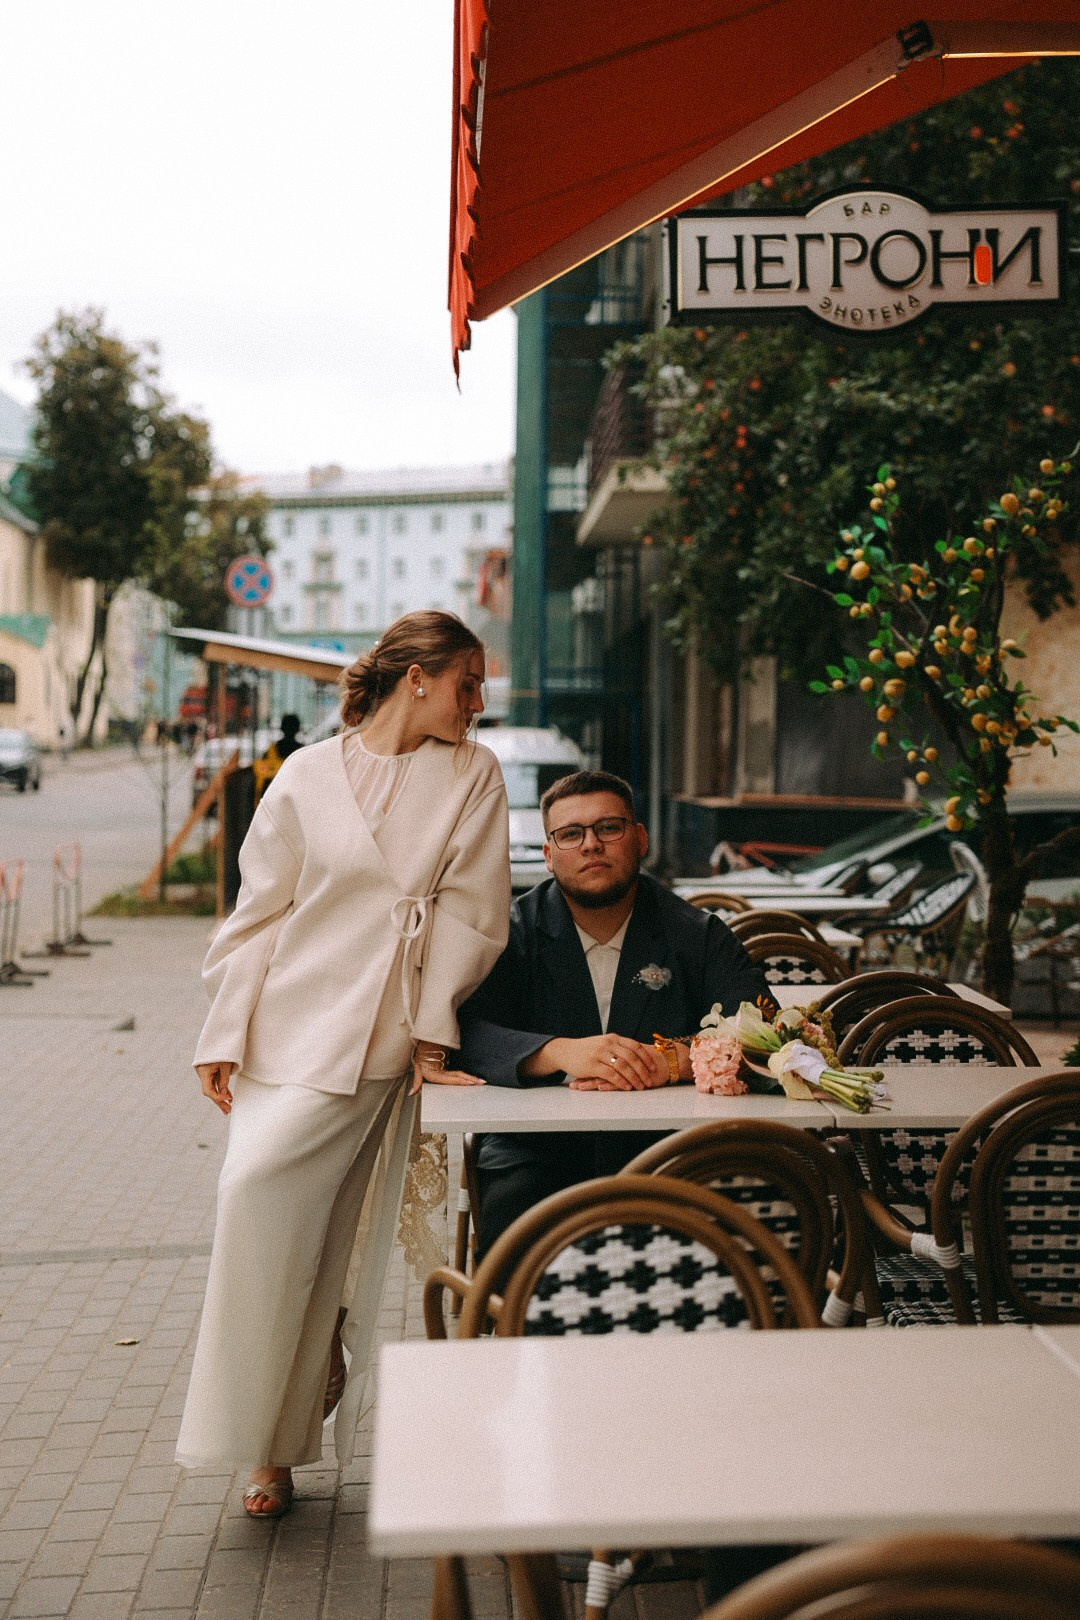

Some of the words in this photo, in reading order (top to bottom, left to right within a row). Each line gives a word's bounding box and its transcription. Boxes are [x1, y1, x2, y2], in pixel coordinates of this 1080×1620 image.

[843, 202, 890, 217] БАР
[697, 227, 1042, 293] НЕГРОНИ
[819, 295, 920, 322] ЭНОТЕКА
